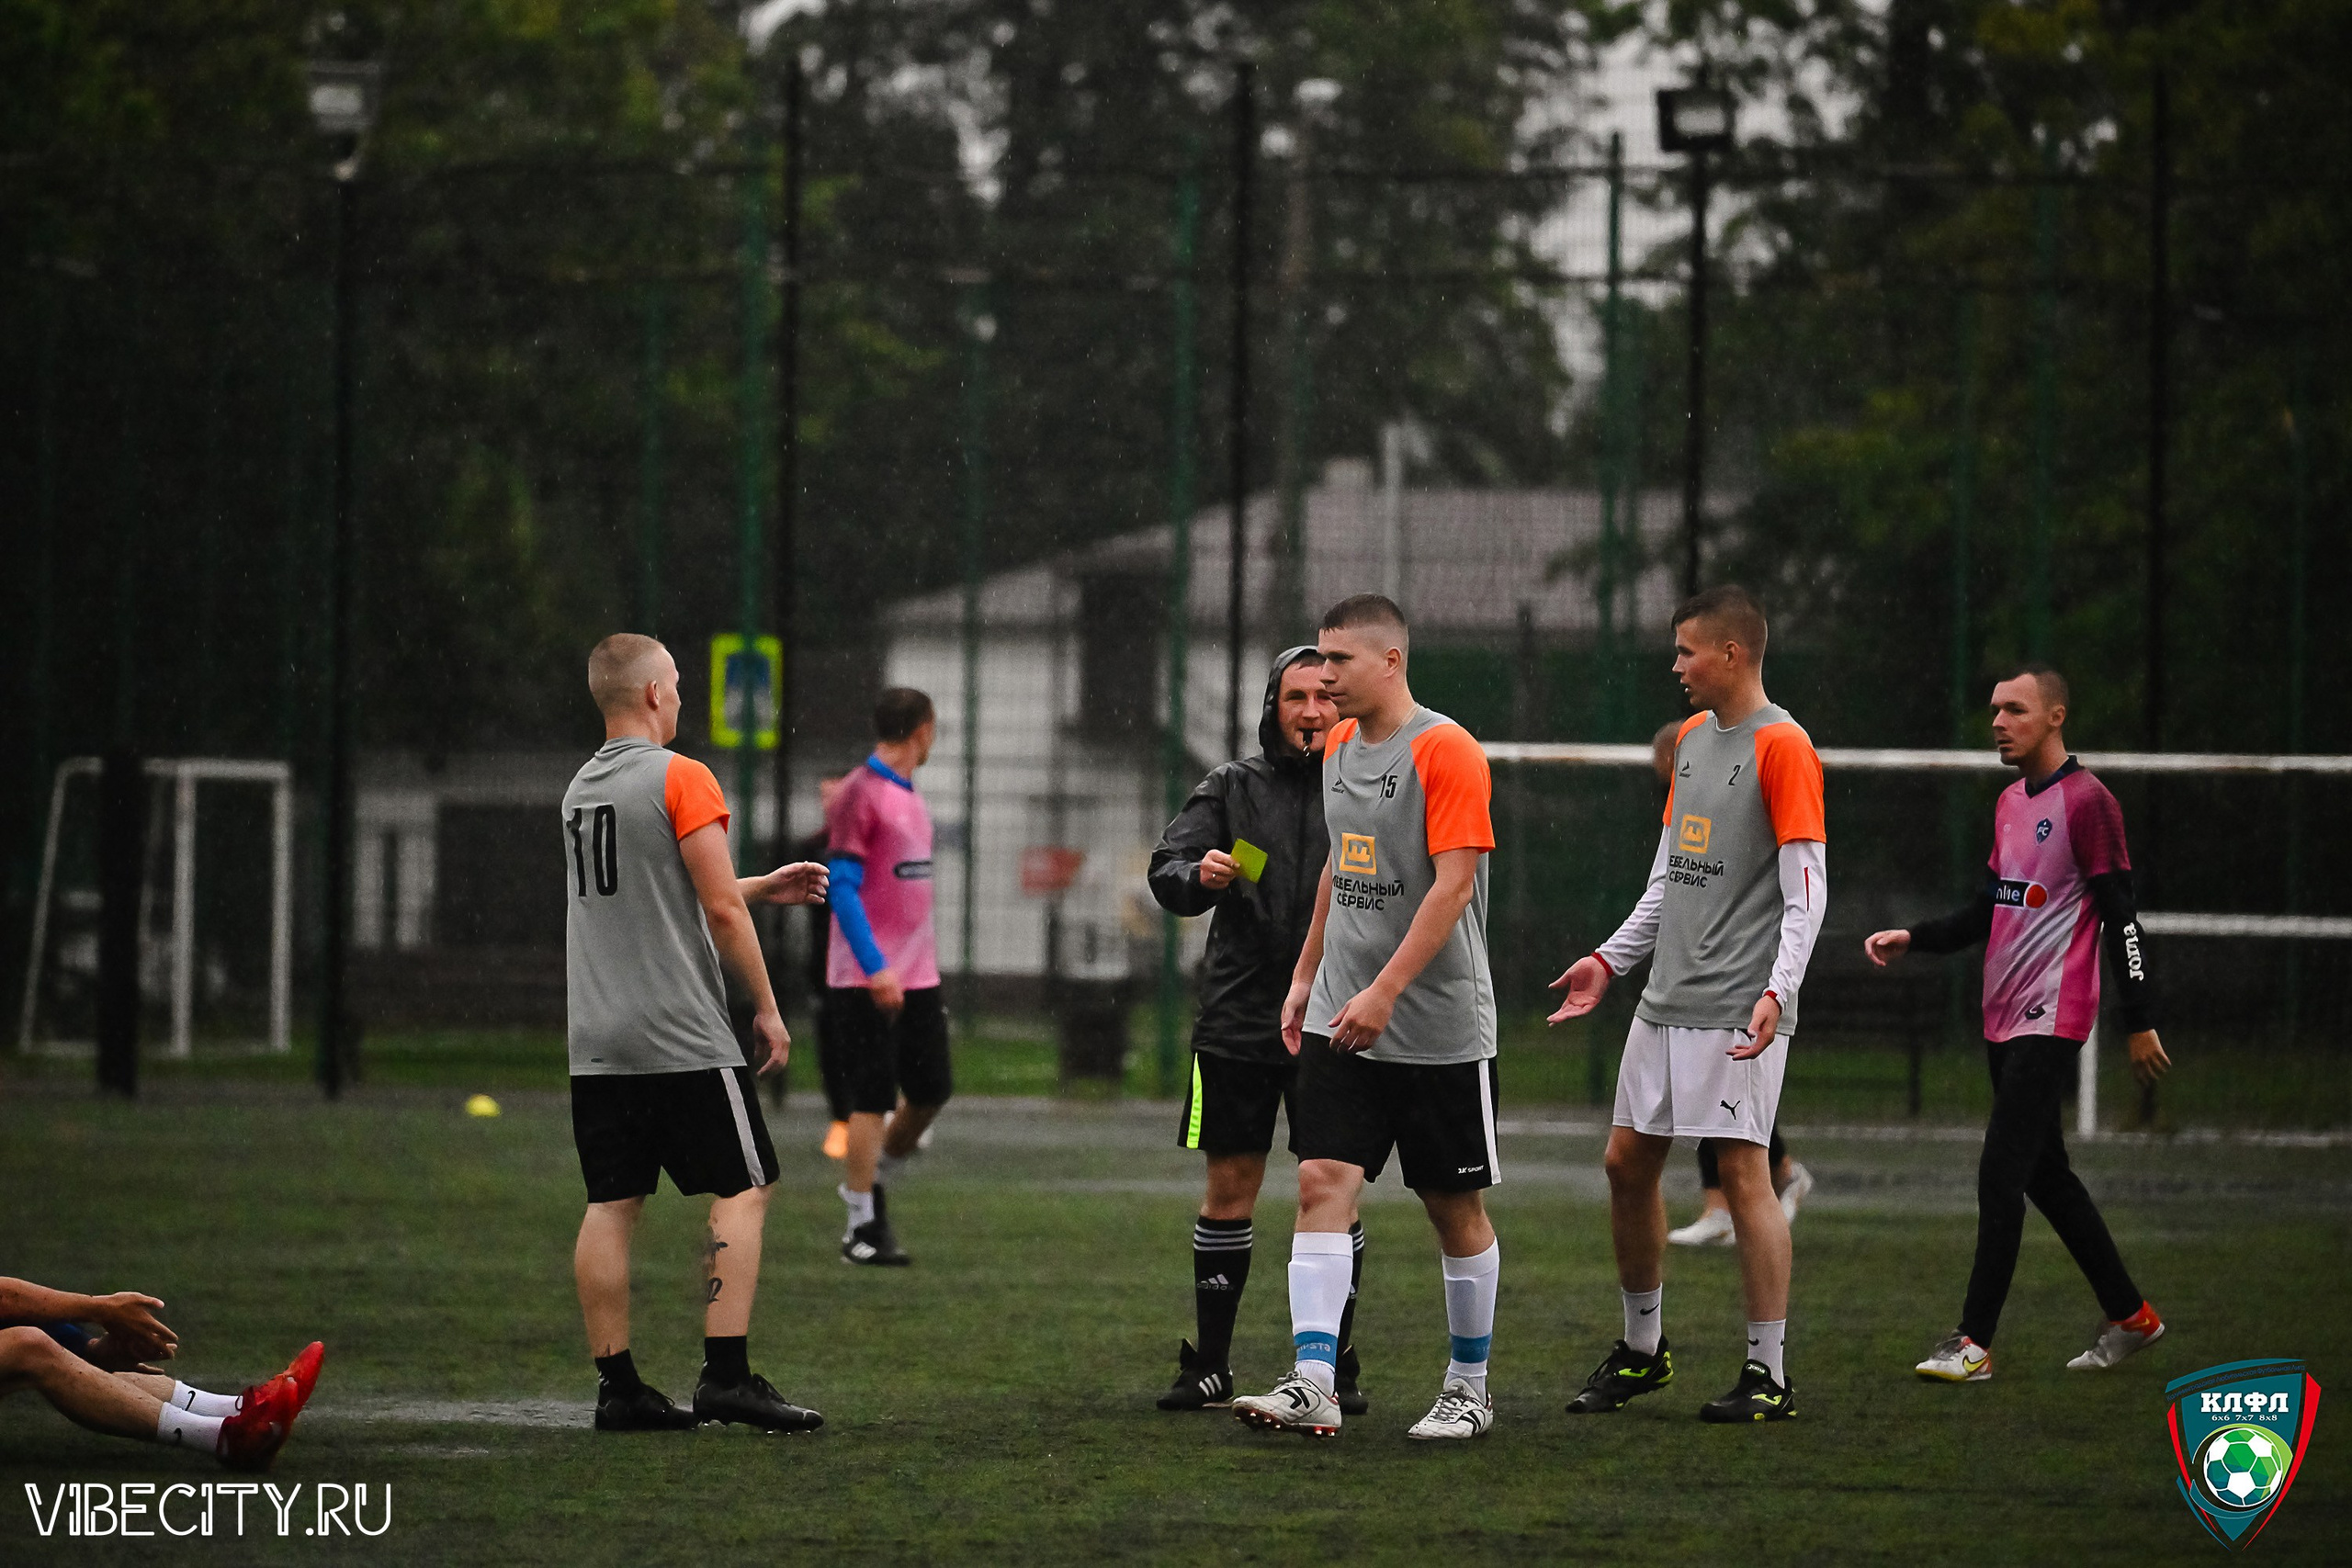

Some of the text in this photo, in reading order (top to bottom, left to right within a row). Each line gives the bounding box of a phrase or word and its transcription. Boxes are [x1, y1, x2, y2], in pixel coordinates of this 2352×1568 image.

[1728, 764, 1741, 785] 2
[1379, 774, 1398, 798] 15
[566, 805, 618, 897] 10
[1668, 870, 1708, 888] СЕРВИС
[1337, 892, 1385, 911] СЕРВИС
